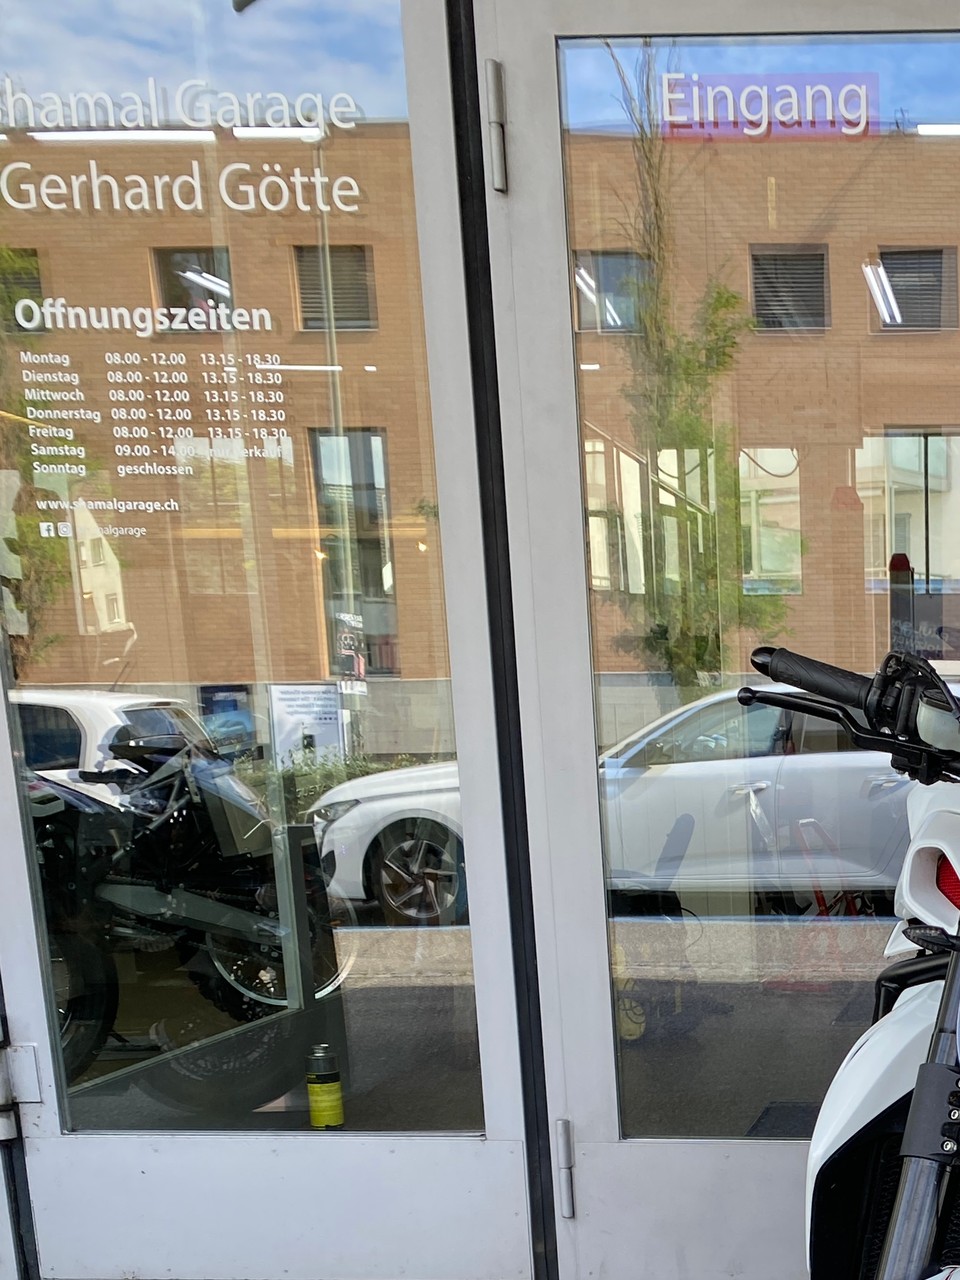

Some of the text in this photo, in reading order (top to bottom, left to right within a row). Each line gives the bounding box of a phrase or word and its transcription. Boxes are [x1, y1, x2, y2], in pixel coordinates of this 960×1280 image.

[0, 77, 357, 143] hamal Garage
[661, 72, 868, 136] Eingang
[0, 159, 360, 213] Gerhard Götte
[20, 351, 70, 366] Montag
[105, 352, 140, 365] 08.00
[151, 352, 186, 365] 12.00
[200, 353, 234, 366] 13.15
[246, 353, 280, 366] 18.30
[22, 369, 79, 385] Dienstag
[107, 371, 142, 383] 08.00
[153, 371, 188, 383] 12.00
[202, 371, 236, 384] 13.15
[248, 371, 282, 384] 18.30
[24, 388, 84, 401] Mittwoch
[109, 390, 144, 402] 08.00
[155, 390, 190, 402] 12.00
[204, 390, 238, 403] 13.15
[249, 390, 284, 403] 18.30
[26, 407, 101, 423] Donnerstag
[111, 408, 146, 421] 08.00
[157, 408, 192, 421] 12.00
[206, 409, 240, 422] 13.15
[251, 409, 285, 422] 18.30
[28, 425, 74, 440] Freitag
[113, 427, 148, 439] 08.00
[159, 427, 193, 439] 12.00
[208, 427, 242, 440] 13.15
[253, 427, 287, 440] 18.30
[30, 443, 85, 459] Samstag
[115, 444, 150, 457] 09.00
[32, 461, 194, 477] Sonntag geschlossen
